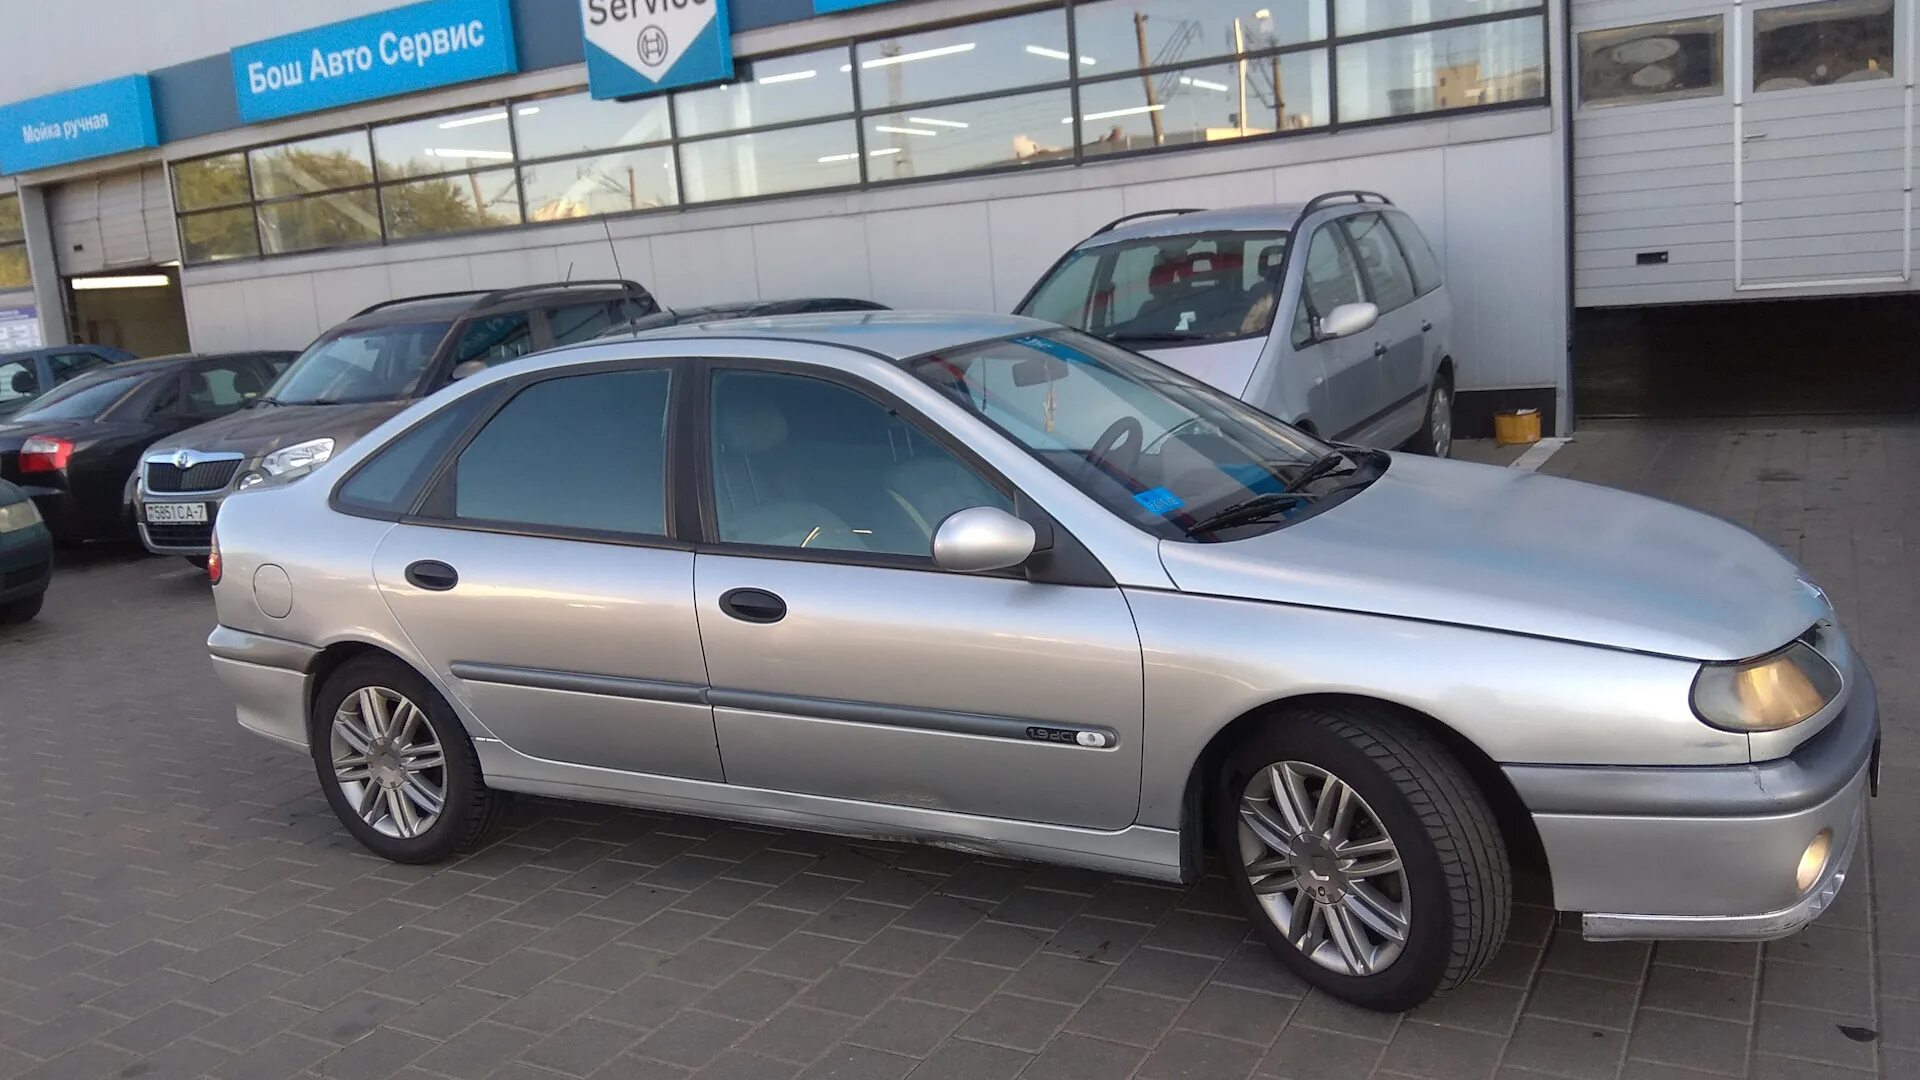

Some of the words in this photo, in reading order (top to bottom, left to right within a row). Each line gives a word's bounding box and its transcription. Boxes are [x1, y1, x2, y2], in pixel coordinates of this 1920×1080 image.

[588, 0, 707, 25] Serv
[248, 61, 303, 94] Бош
[309, 48, 373, 81] Авто
[379, 19, 485, 67] Сервис
[22, 122, 61, 144] Мойка
[63, 113, 108, 140] ручная
